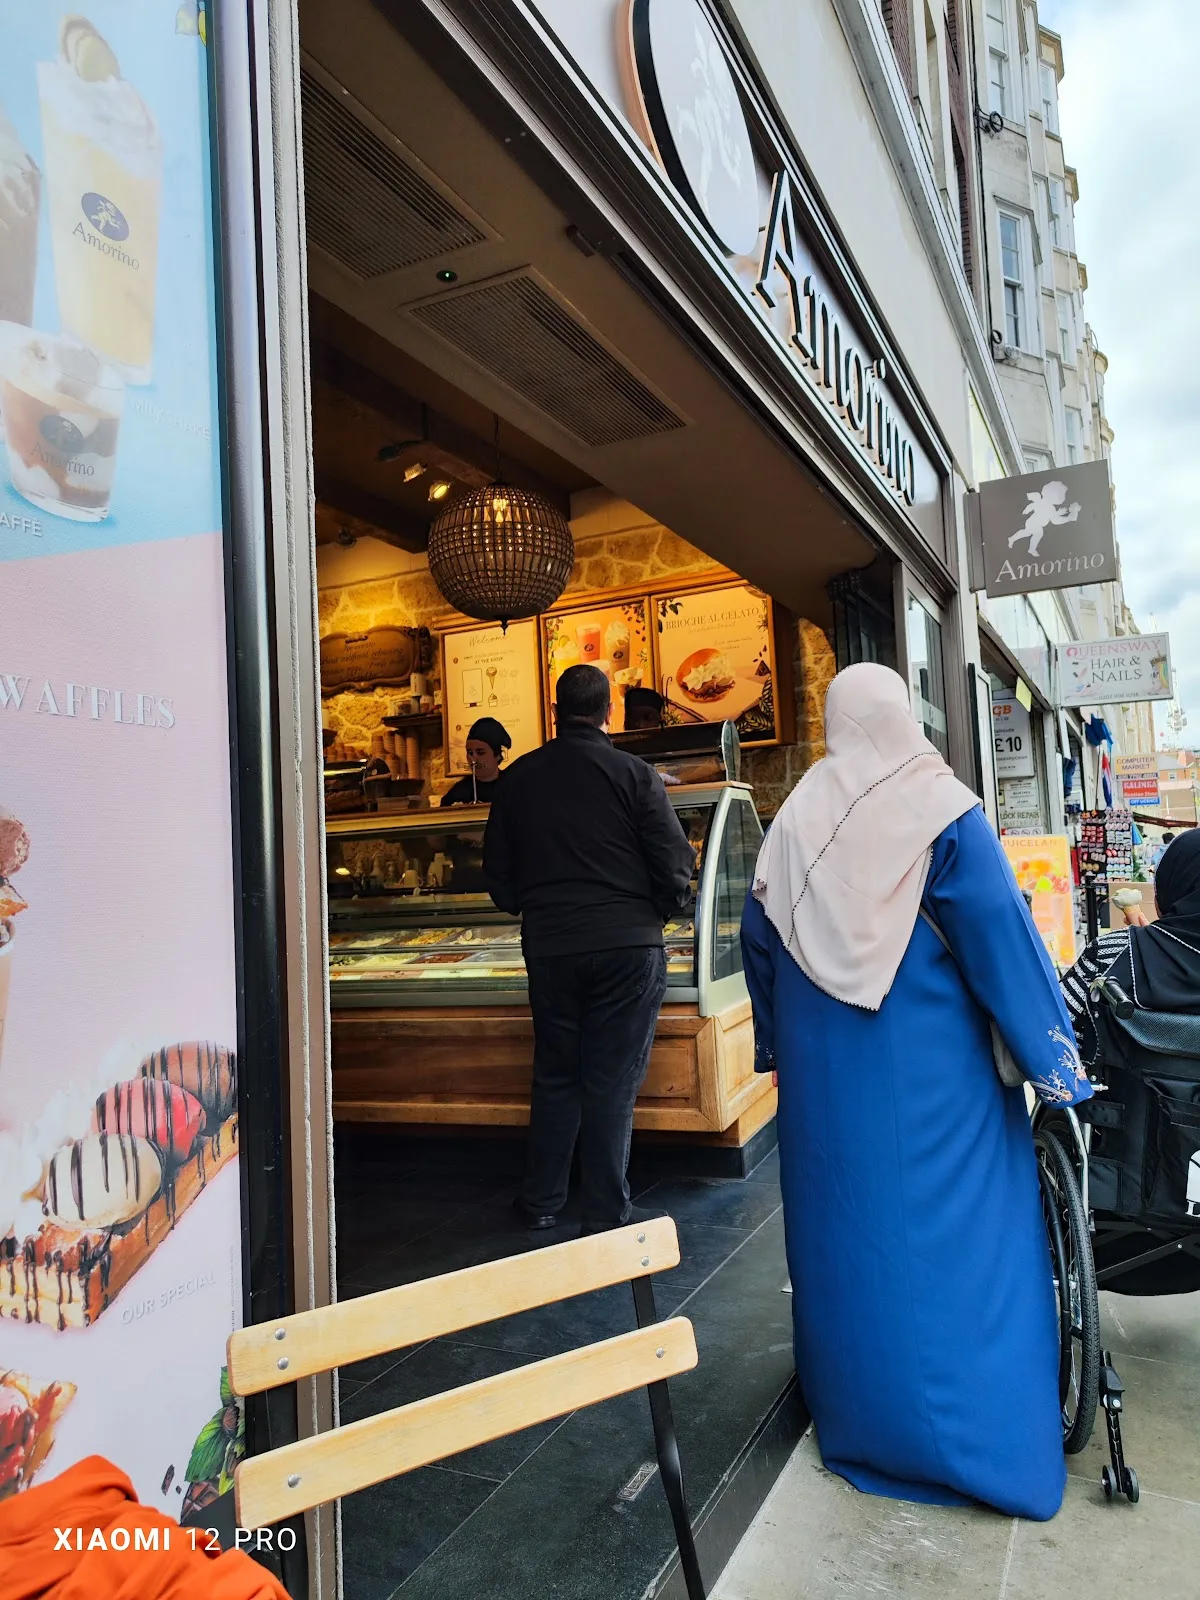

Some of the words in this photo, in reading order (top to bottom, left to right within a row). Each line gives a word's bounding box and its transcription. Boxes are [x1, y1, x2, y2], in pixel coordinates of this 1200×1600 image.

[72, 222, 140, 270] Amorino
[754, 169, 915, 507] Amorino
[994, 552, 1105, 583] Amorino
[666, 616, 707, 630] BRIOCHE
[707, 614, 720, 623] AL
[721, 607, 760, 621] GELATO
[469, 634, 509, 647] Welcome
[1066, 640, 1161, 659] QUEENSWAY
[1091, 657, 1126, 670] HAIR
[1129, 655, 1141, 666] &
[1091, 669, 1143, 684] NAILS
[0, 674, 176, 729] WAFFLES
[994, 736, 1022, 753] £10
[1116, 757, 1156, 765] COMPUTER
[1123, 780, 1157, 789] KALINKA
[122, 1299, 155, 1325] OUR
[160, 1270, 216, 1308] SPECIAL
